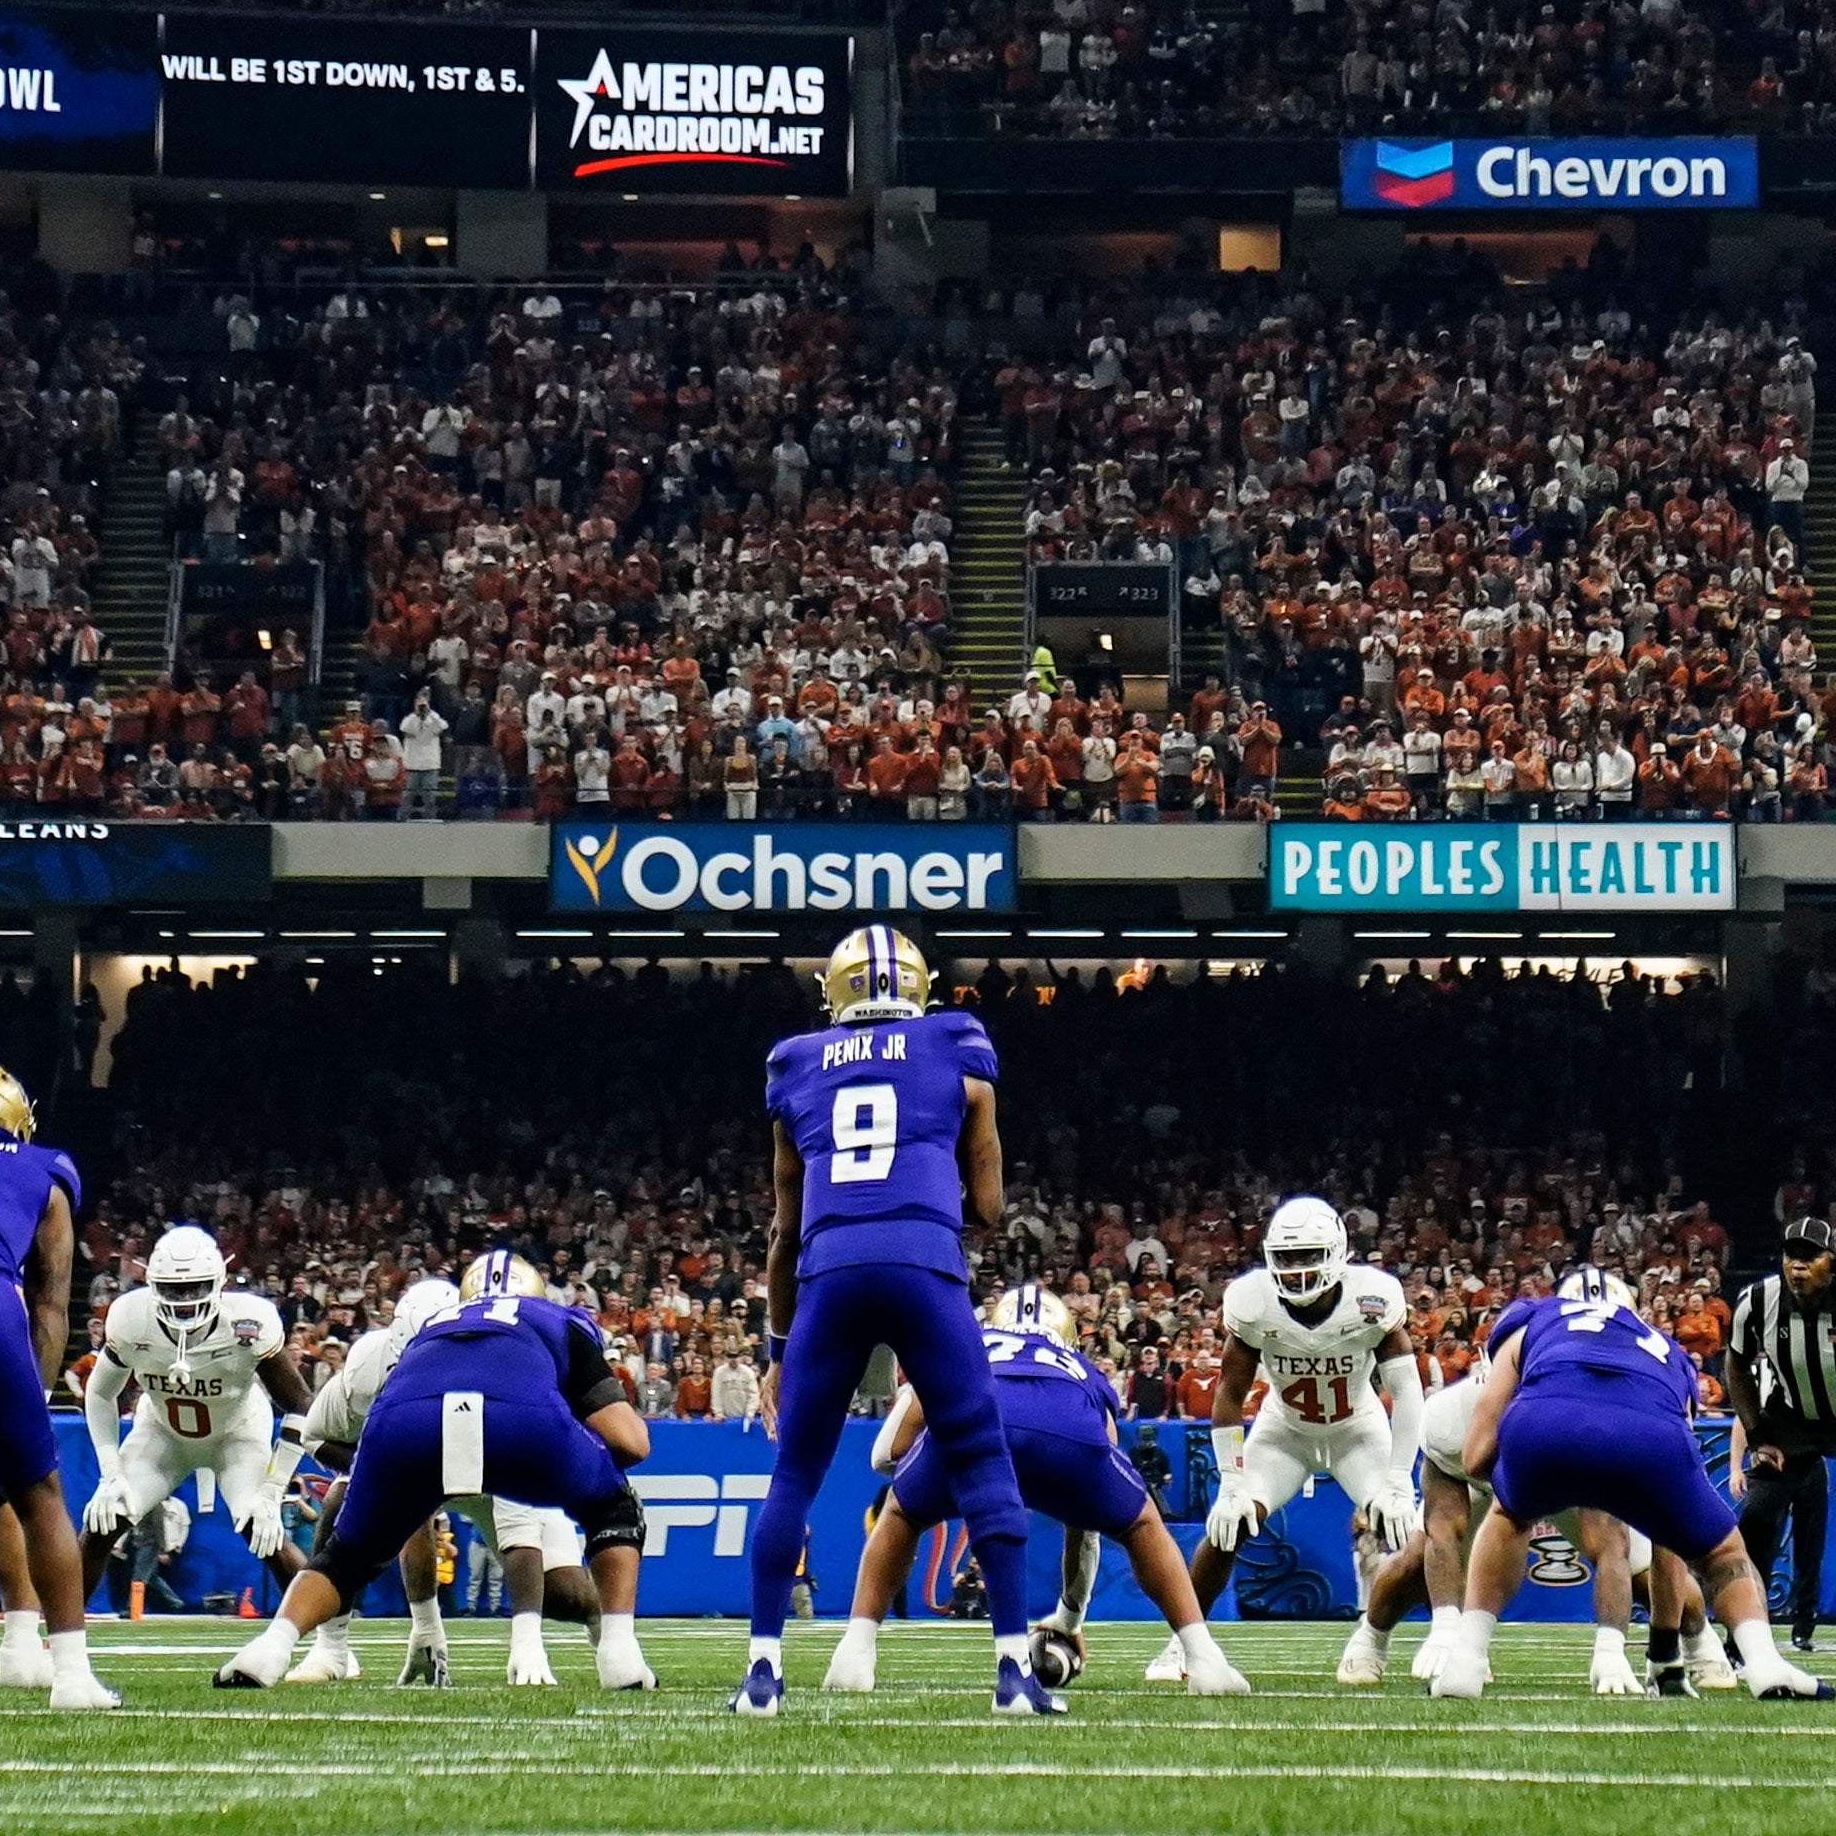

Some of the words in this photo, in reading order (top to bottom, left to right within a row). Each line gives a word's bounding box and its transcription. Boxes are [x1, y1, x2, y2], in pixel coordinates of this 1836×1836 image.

[162, 55, 226, 83] WILL
[231, 58, 266, 83] BE
[272, 60, 320, 86] 1ST
[325, 63, 416, 94] DOWN,
[422, 65, 471, 91] 1ST
[475, 66, 496, 91] &
[500, 69, 525, 94] 5.
[556, 47, 825, 119] AMERICAS
[589, 114, 824, 156] CARDROOM.NET
[1476, 146, 1726, 198] Chevron
[620, 834, 1004, 911] Ochsner
[1283, 839, 1505, 896] PEOPLES
[1530, 840, 1722, 896] HEALTH
[822, 1035, 873, 1071] PENIX
[881, 1034, 907, 1061] JR
[830, 1083, 898, 1184] 9
[1273, 1354, 1354, 1376] TEXAS
[165, 1397, 212, 1439] 0
[1281, 1376, 1355, 1424] 41
